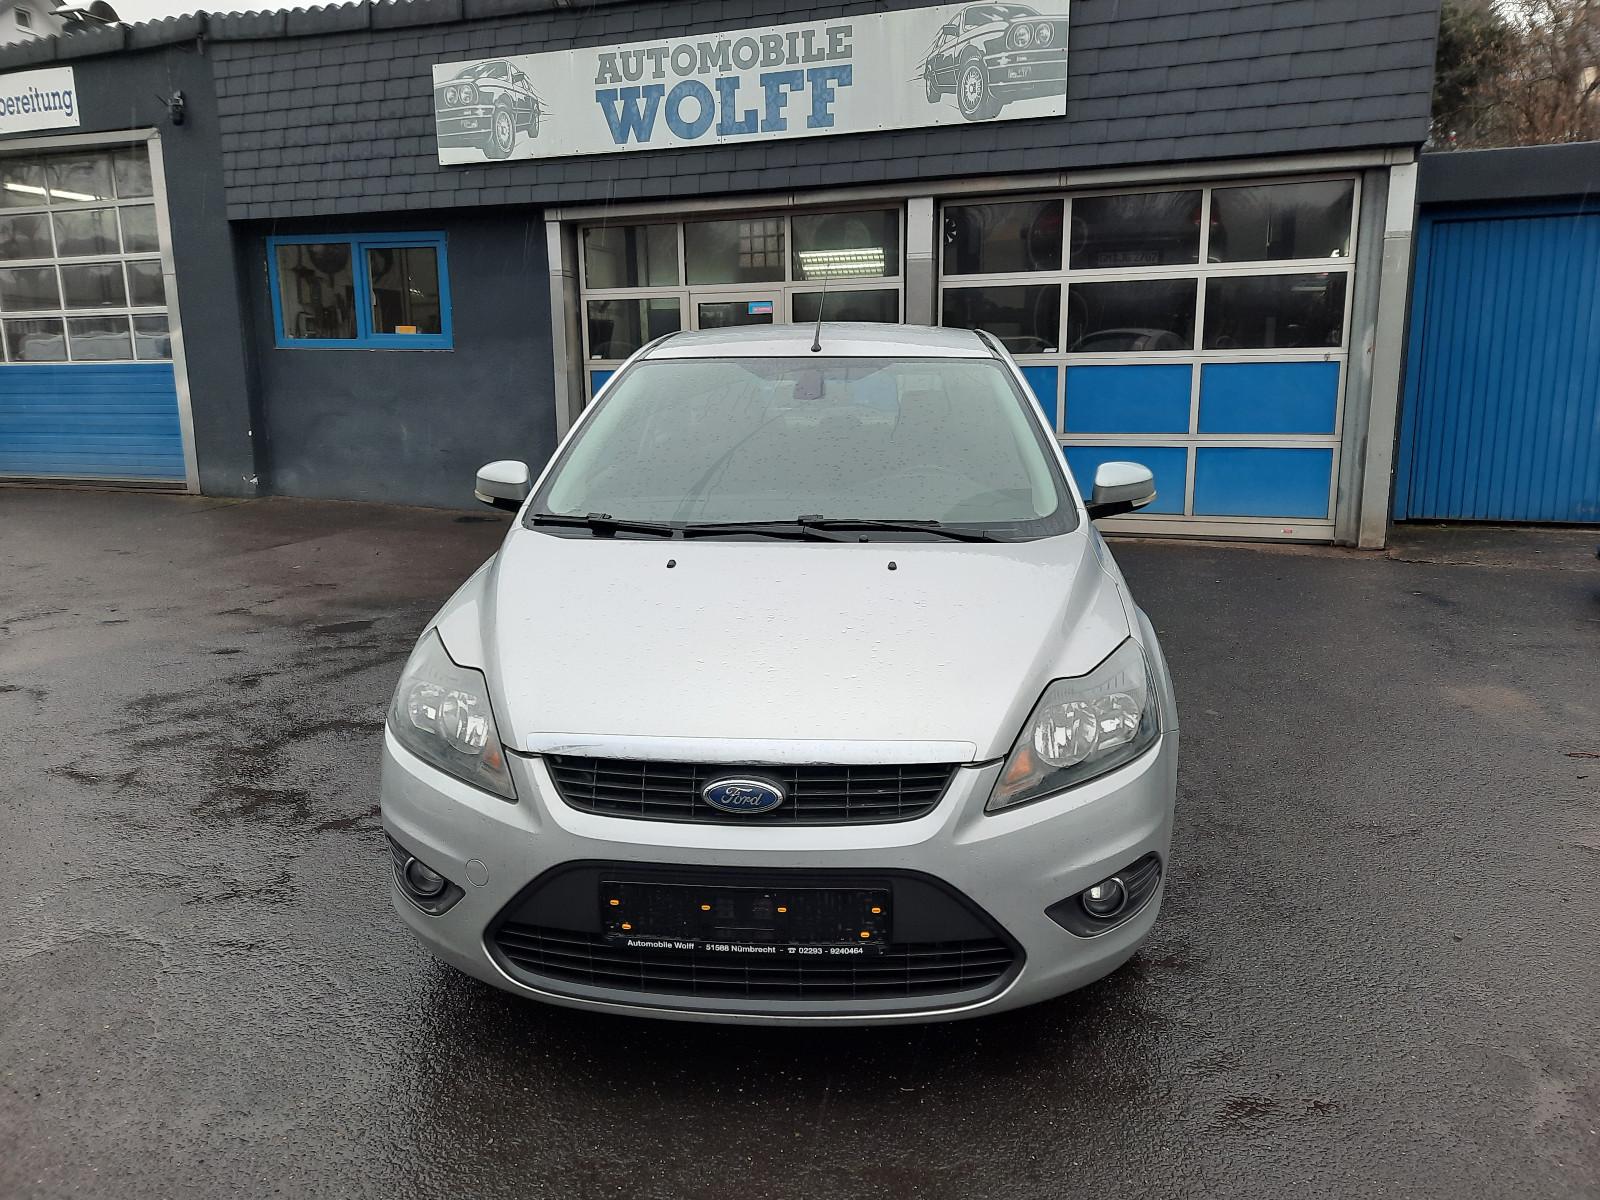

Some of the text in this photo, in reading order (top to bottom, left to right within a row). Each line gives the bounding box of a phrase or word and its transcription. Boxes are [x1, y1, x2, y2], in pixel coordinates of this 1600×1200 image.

[595, 25, 853, 85] AUTOMOBILE
[595, 64, 853, 145] WOLFF
[720, 786, 763, 806] Ford
[627, 939, 864, 955] Automobile Wolff 51588 Nümbrecht 02293 9240464
